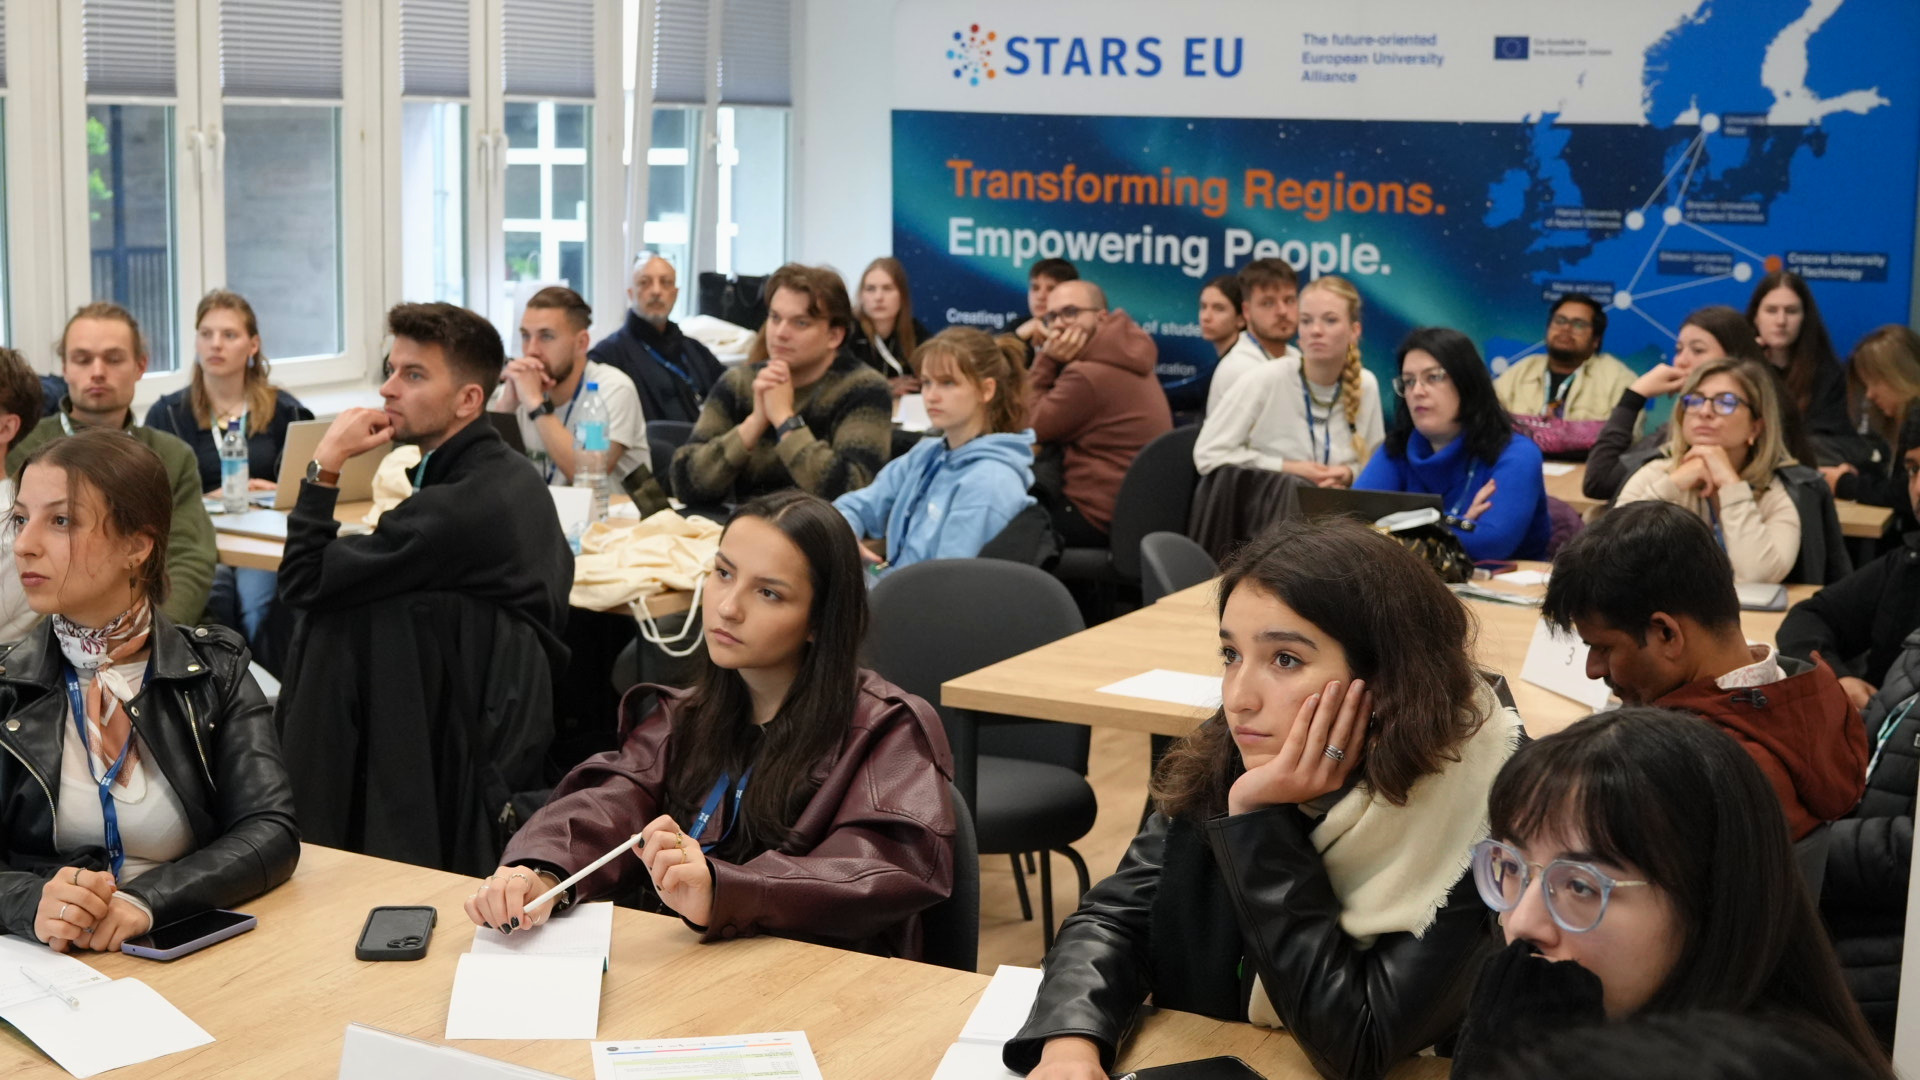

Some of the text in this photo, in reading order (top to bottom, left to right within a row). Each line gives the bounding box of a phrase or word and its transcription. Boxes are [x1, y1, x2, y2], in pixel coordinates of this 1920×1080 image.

[1303, 33, 1437, 46] The future-oriented
[1005, 36, 1244, 79] STARS EU
[1302, 51, 1444, 68] European University
[1302, 70, 1357, 83] Alliance
[946, 160, 1447, 222] Transforming Regions.
[948, 216, 1391, 282] Empowering People.
[1787, 252, 1886, 269] Cracow University
[1801, 266, 1863, 281] Technology
[946, 307, 1004, 330] Creating
[1565, 646, 1576, 666] 3
